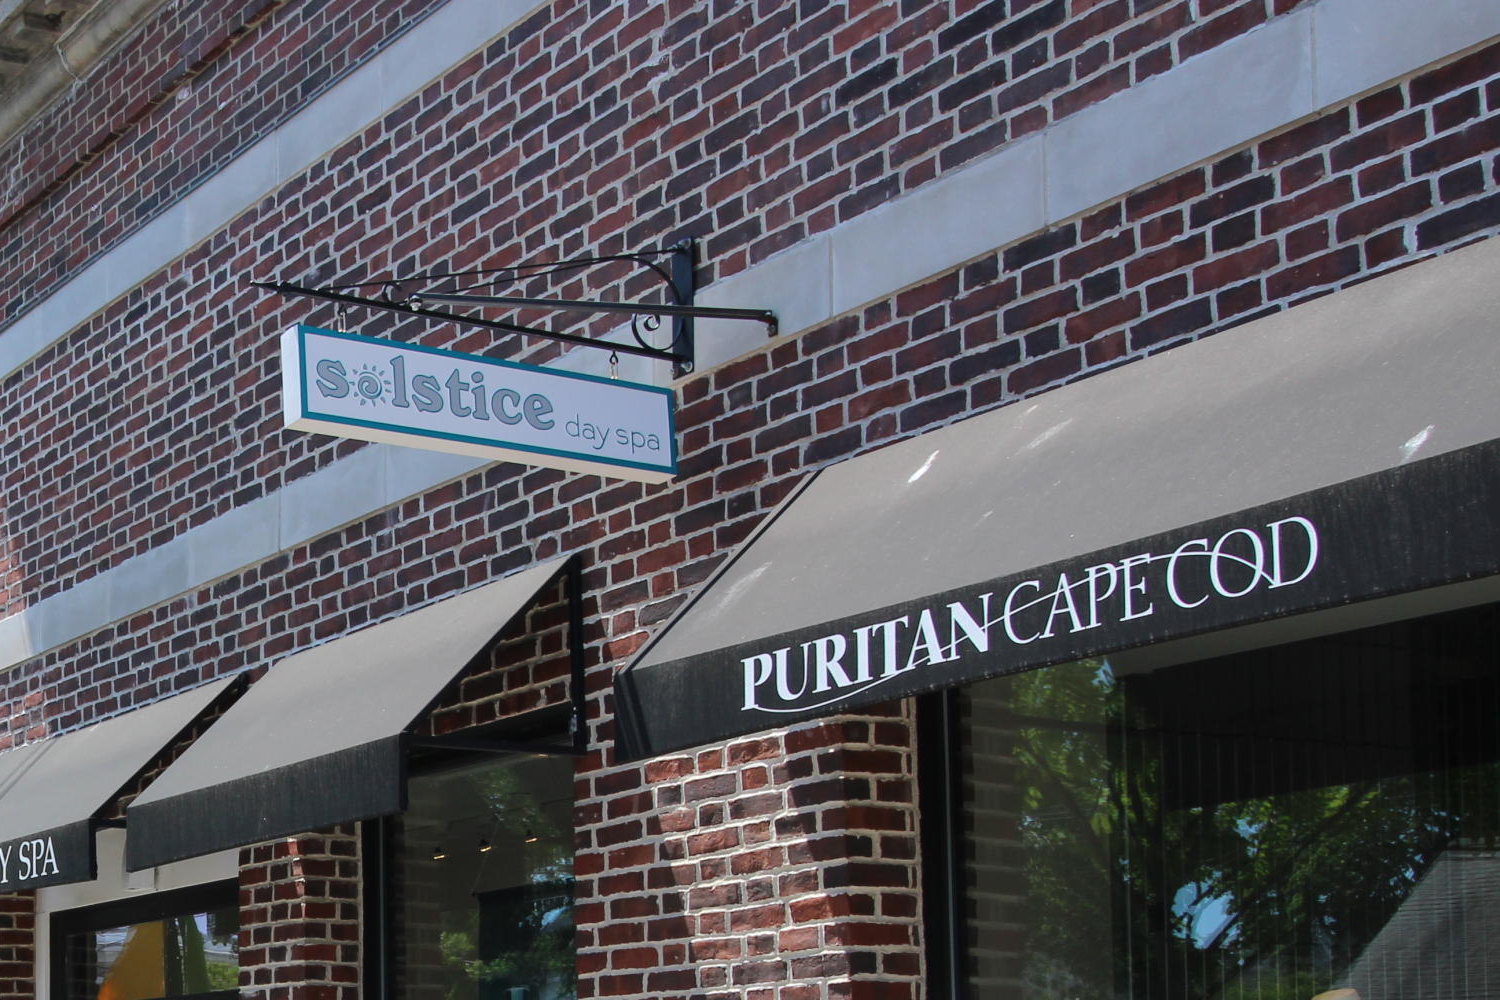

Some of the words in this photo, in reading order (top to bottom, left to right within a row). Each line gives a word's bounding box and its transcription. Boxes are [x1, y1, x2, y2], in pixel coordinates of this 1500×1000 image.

[565, 414, 610, 450] day
[616, 427, 661, 454] spa
[740, 592, 994, 712] PURITAN
[1003, 552, 1153, 645] CAPE
[1165, 516, 1319, 609] COD
[18, 836, 60, 881] SPA
